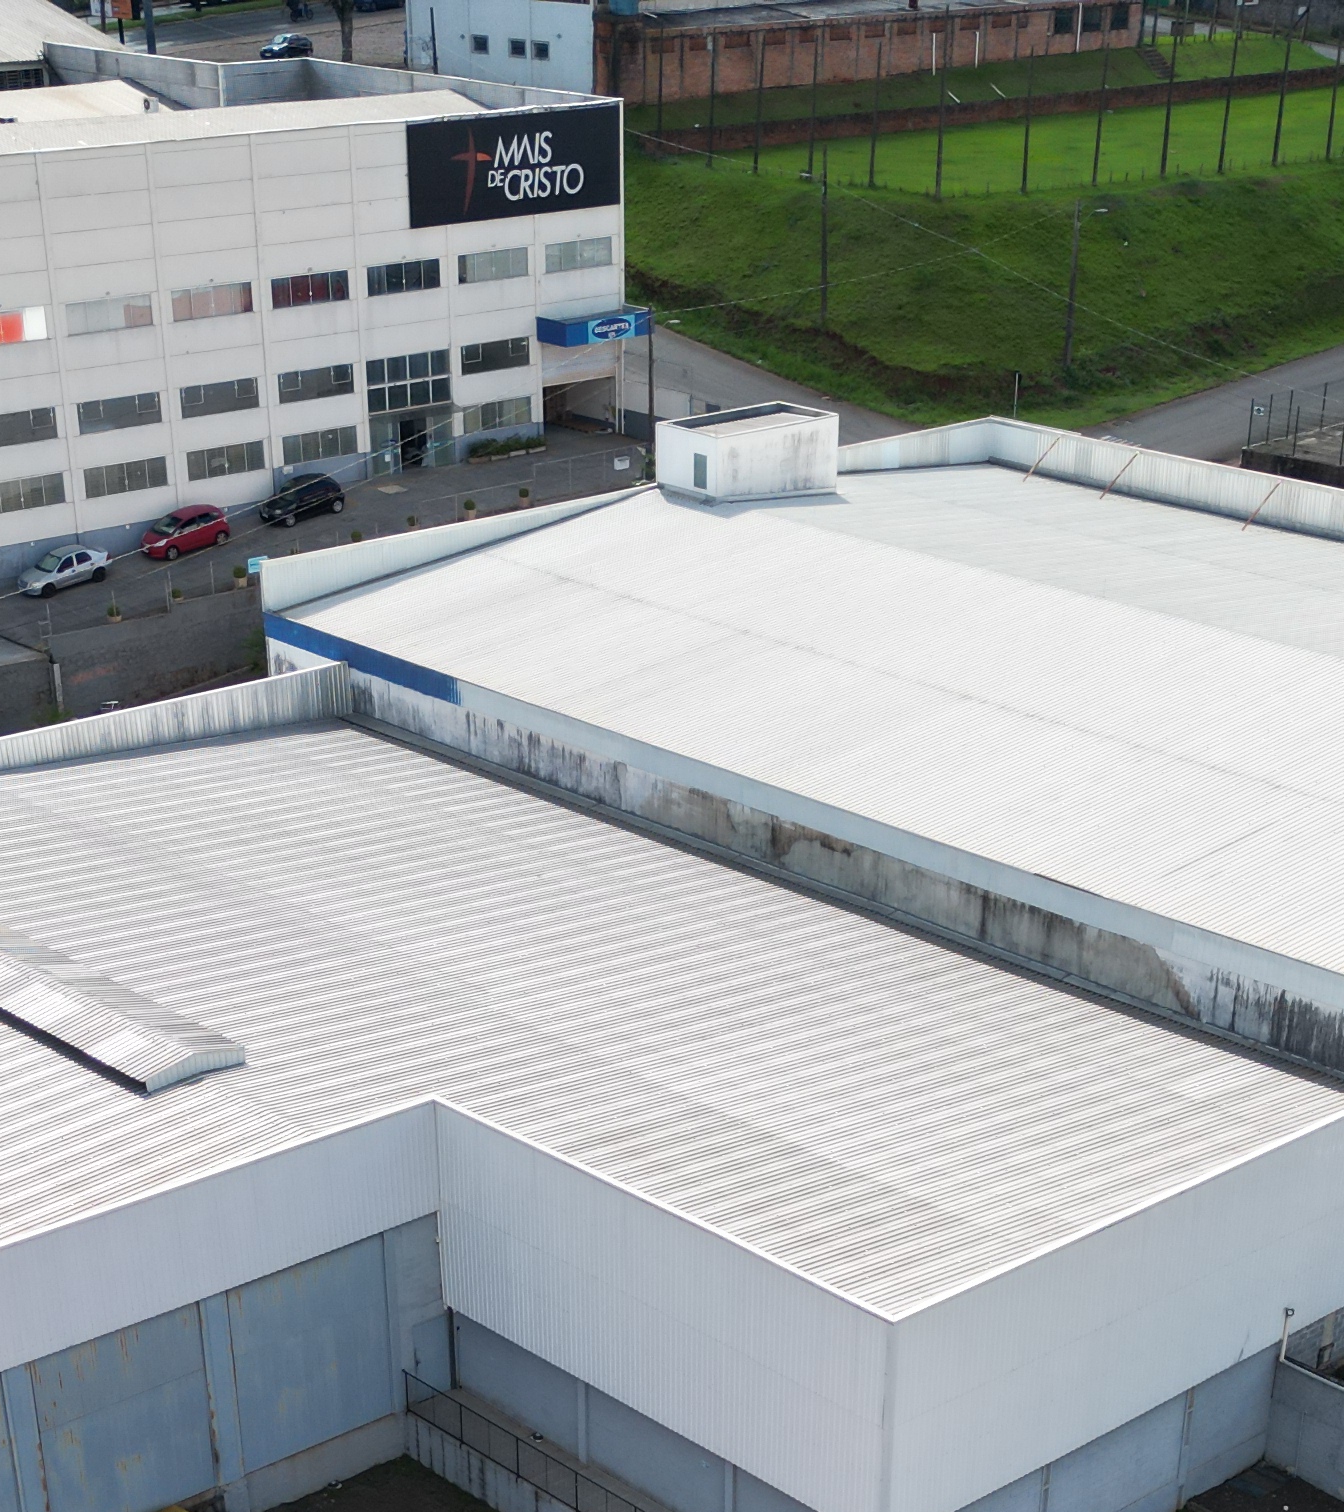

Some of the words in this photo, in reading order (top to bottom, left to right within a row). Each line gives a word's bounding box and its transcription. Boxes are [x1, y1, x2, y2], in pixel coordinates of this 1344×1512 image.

[493, 130, 553, 168] MAIS
[487, 169, 505, 188] DE
[504, 163, 585, 201] CRISTO
